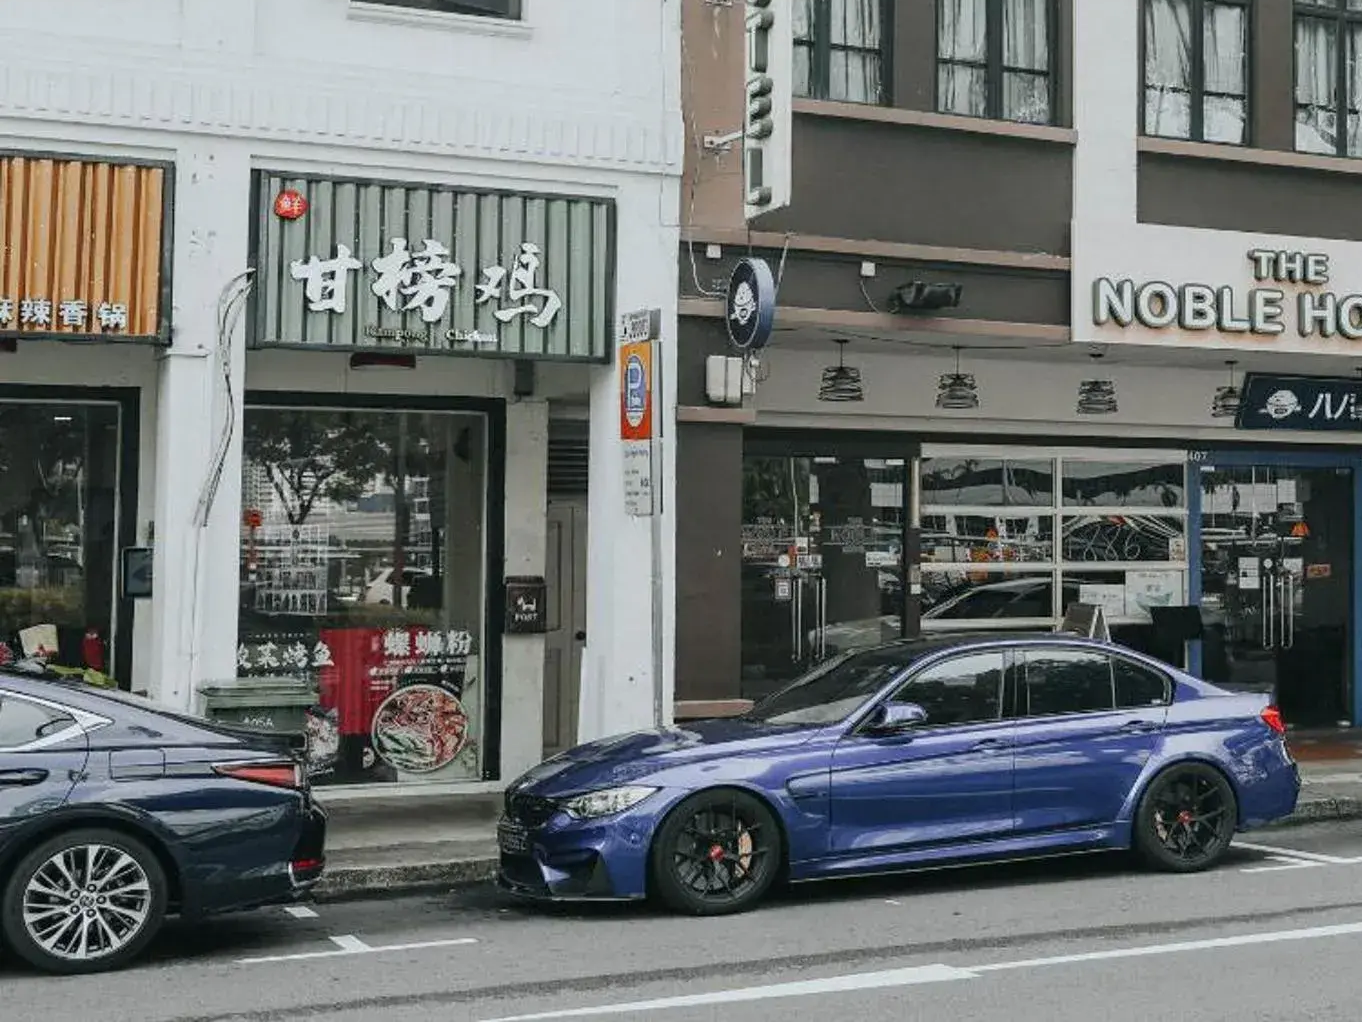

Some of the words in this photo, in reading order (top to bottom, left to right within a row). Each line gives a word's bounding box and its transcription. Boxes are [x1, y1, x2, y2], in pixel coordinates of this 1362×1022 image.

[289, 237, 562, 328] 甘榜鸡
[1247, 248, 1330, 285] THE
[1092, 277, 1286, 336] NOBLE
